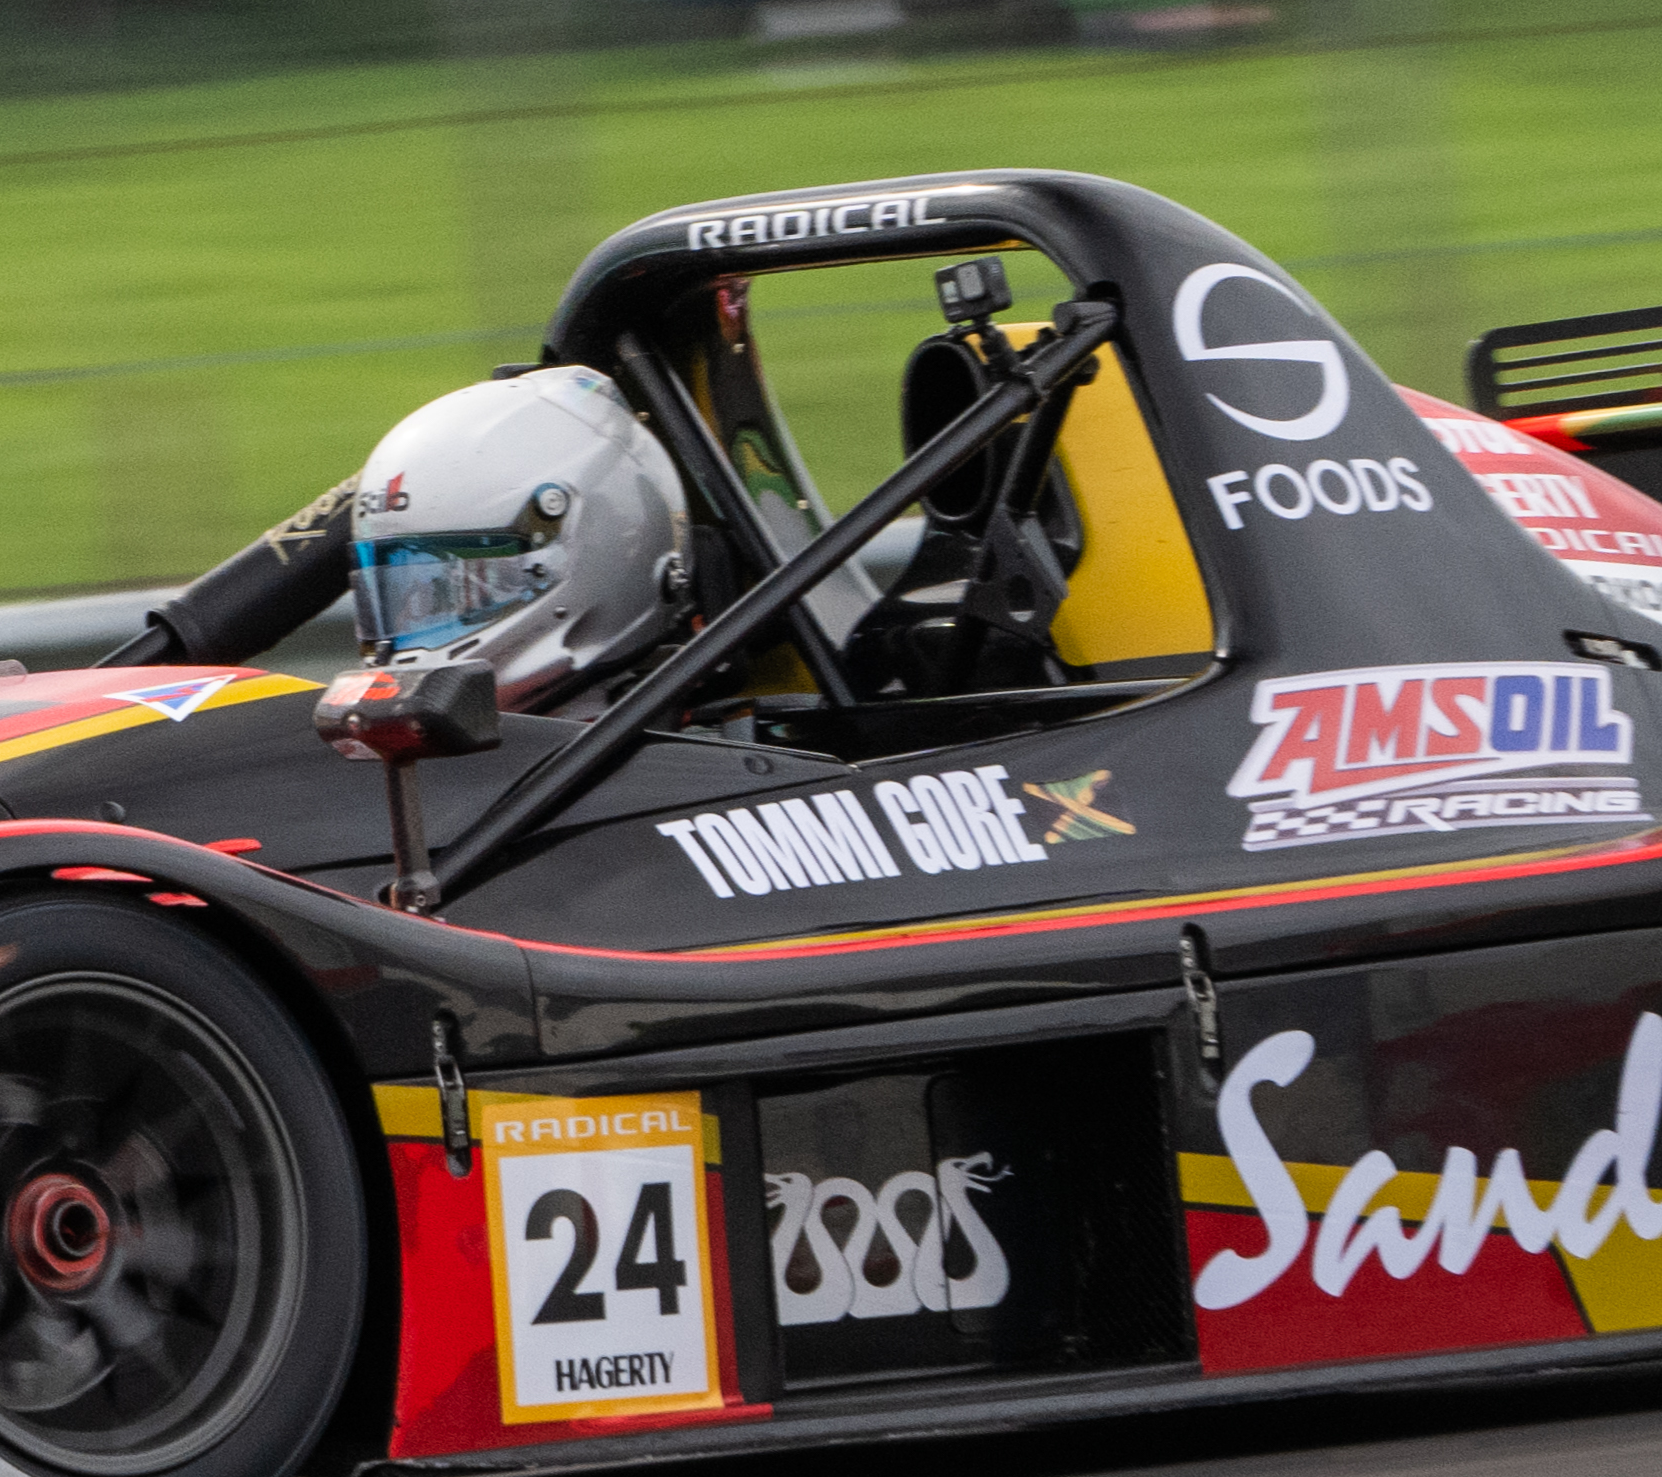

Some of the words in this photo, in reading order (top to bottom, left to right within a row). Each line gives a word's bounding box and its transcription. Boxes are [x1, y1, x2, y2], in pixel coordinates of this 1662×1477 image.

[688, 197, 947, 250] RADICAL
[1209, 458, 1433, 529] FOODS
[1259, 675, 1620, 793] AMSOIL
[656, 789, 902, 899] TOMMI
[874, 765, 1049, 874] GORE
[1386, 790, 1642, 832] RACING
[494, 1110, 693, 1143] RADICAL
[525, 1182, 688, 1326] 24
[555, 1352, 675, 1393] HAGERTY
